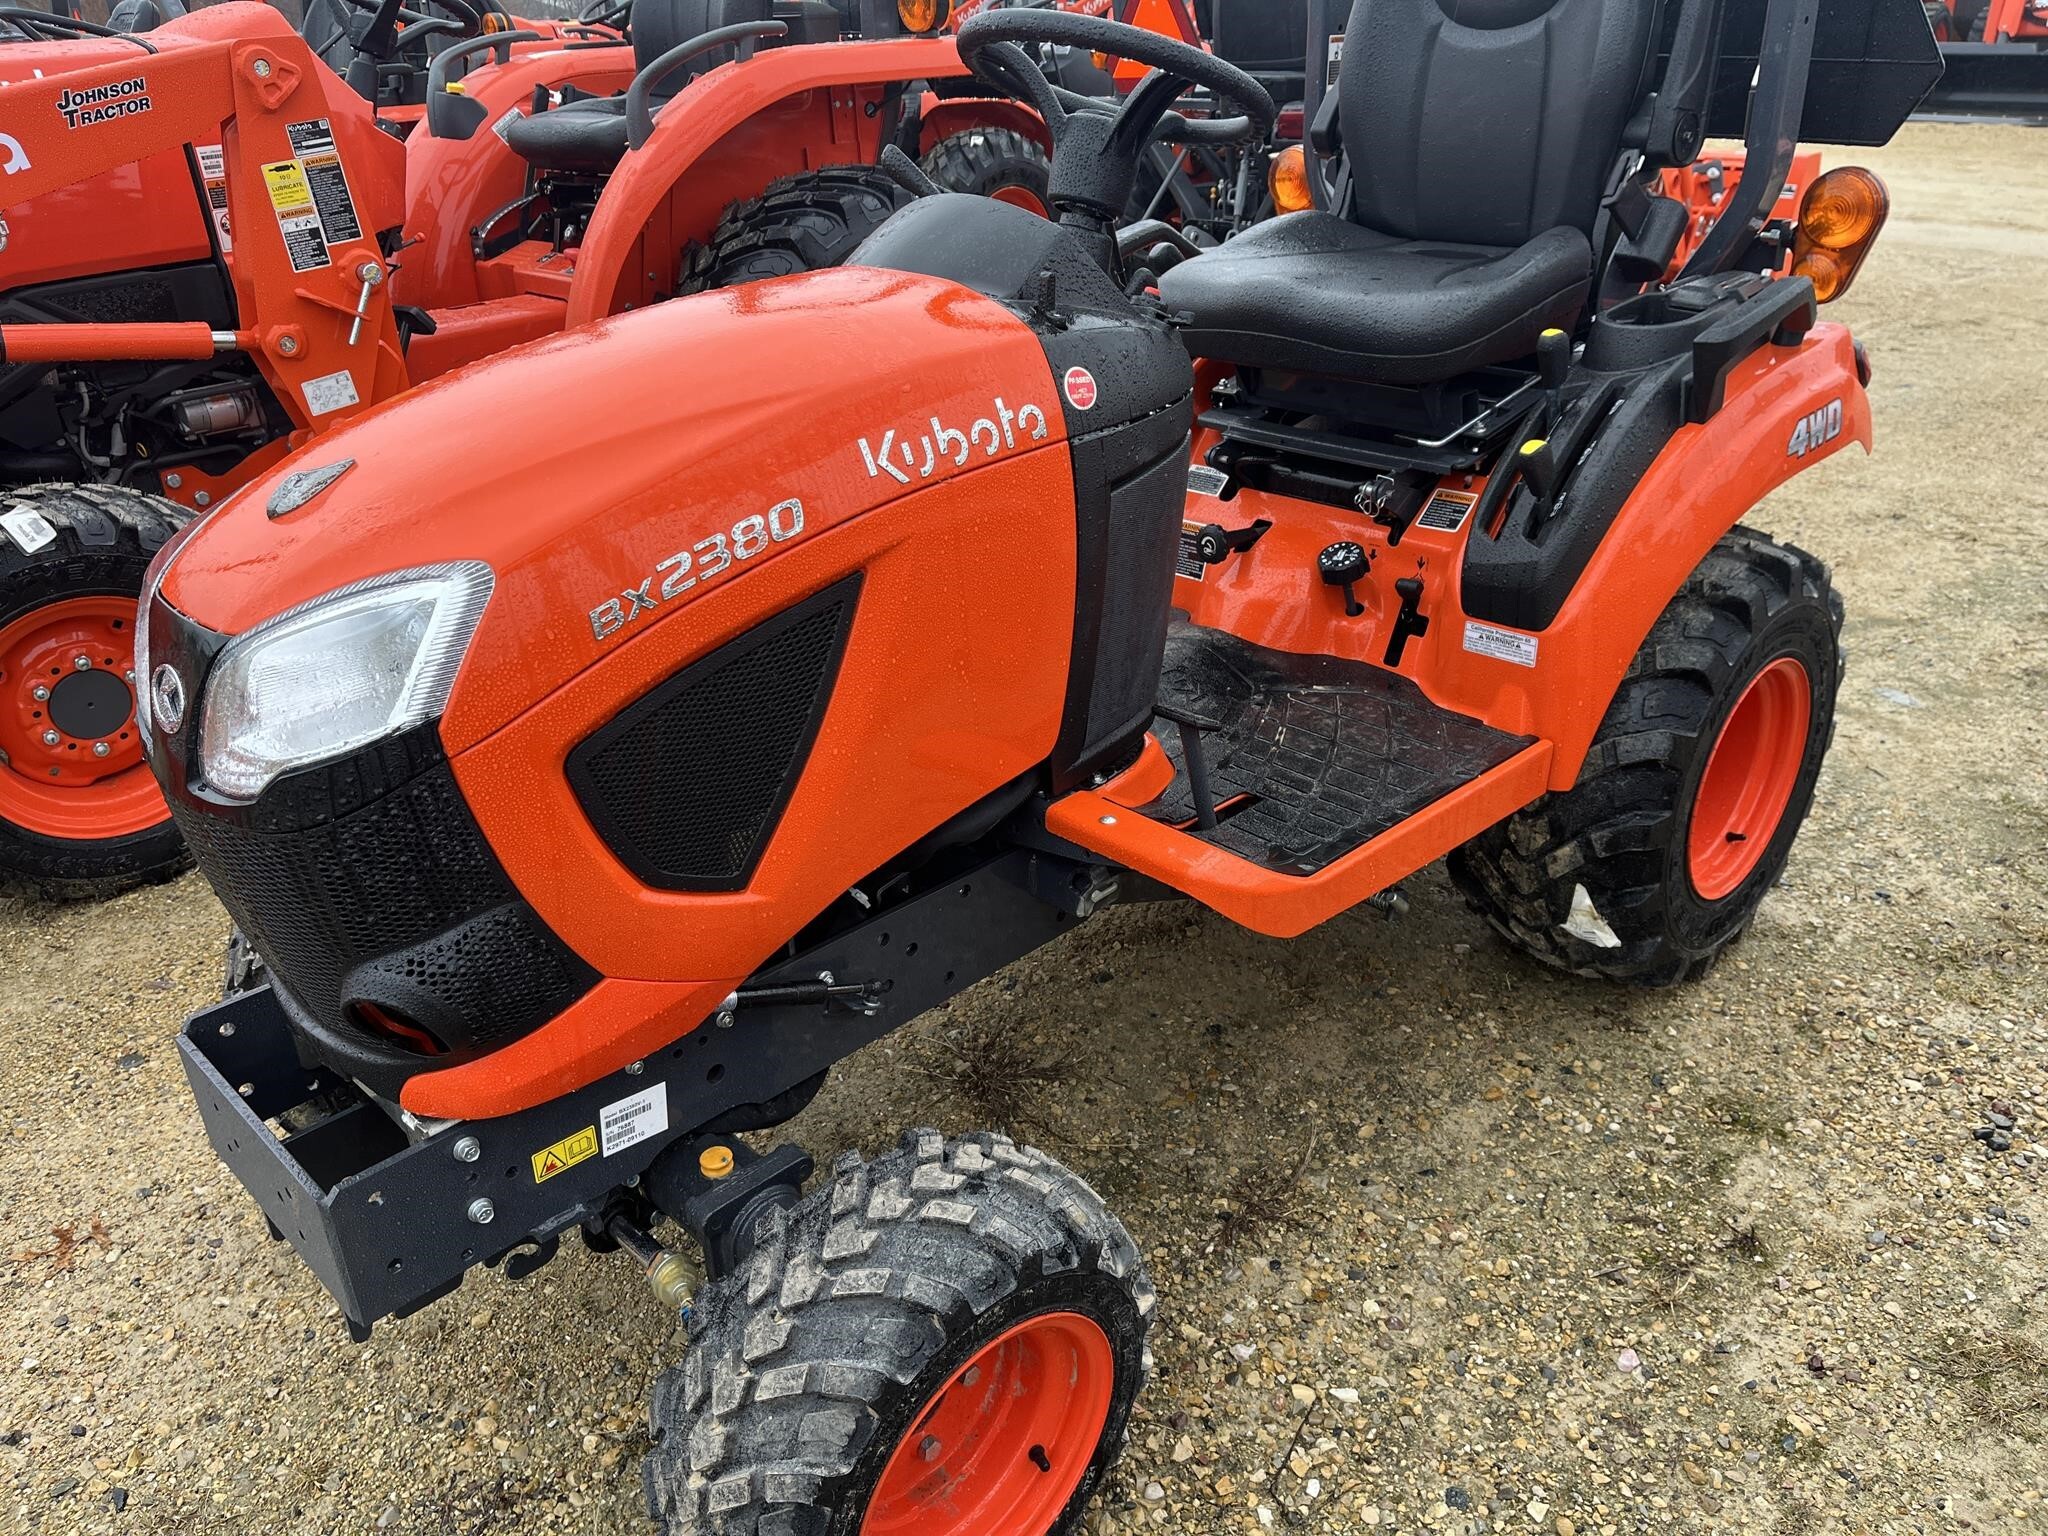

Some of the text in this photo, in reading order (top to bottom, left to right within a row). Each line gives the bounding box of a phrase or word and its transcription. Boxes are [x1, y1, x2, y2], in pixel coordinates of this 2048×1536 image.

[56, 77, 146, 110] JOHNSON
[63, 97, 152, 129] TRACTOR
[271, 182, 304, 193] LUBRICATE
[857, 397, 1048, 484] Kubota
[1787, 397, 1842, 458] 4WD
[588, 497, 805, 641] BX2380
[1485, 634, 1515, 648] WARNING
